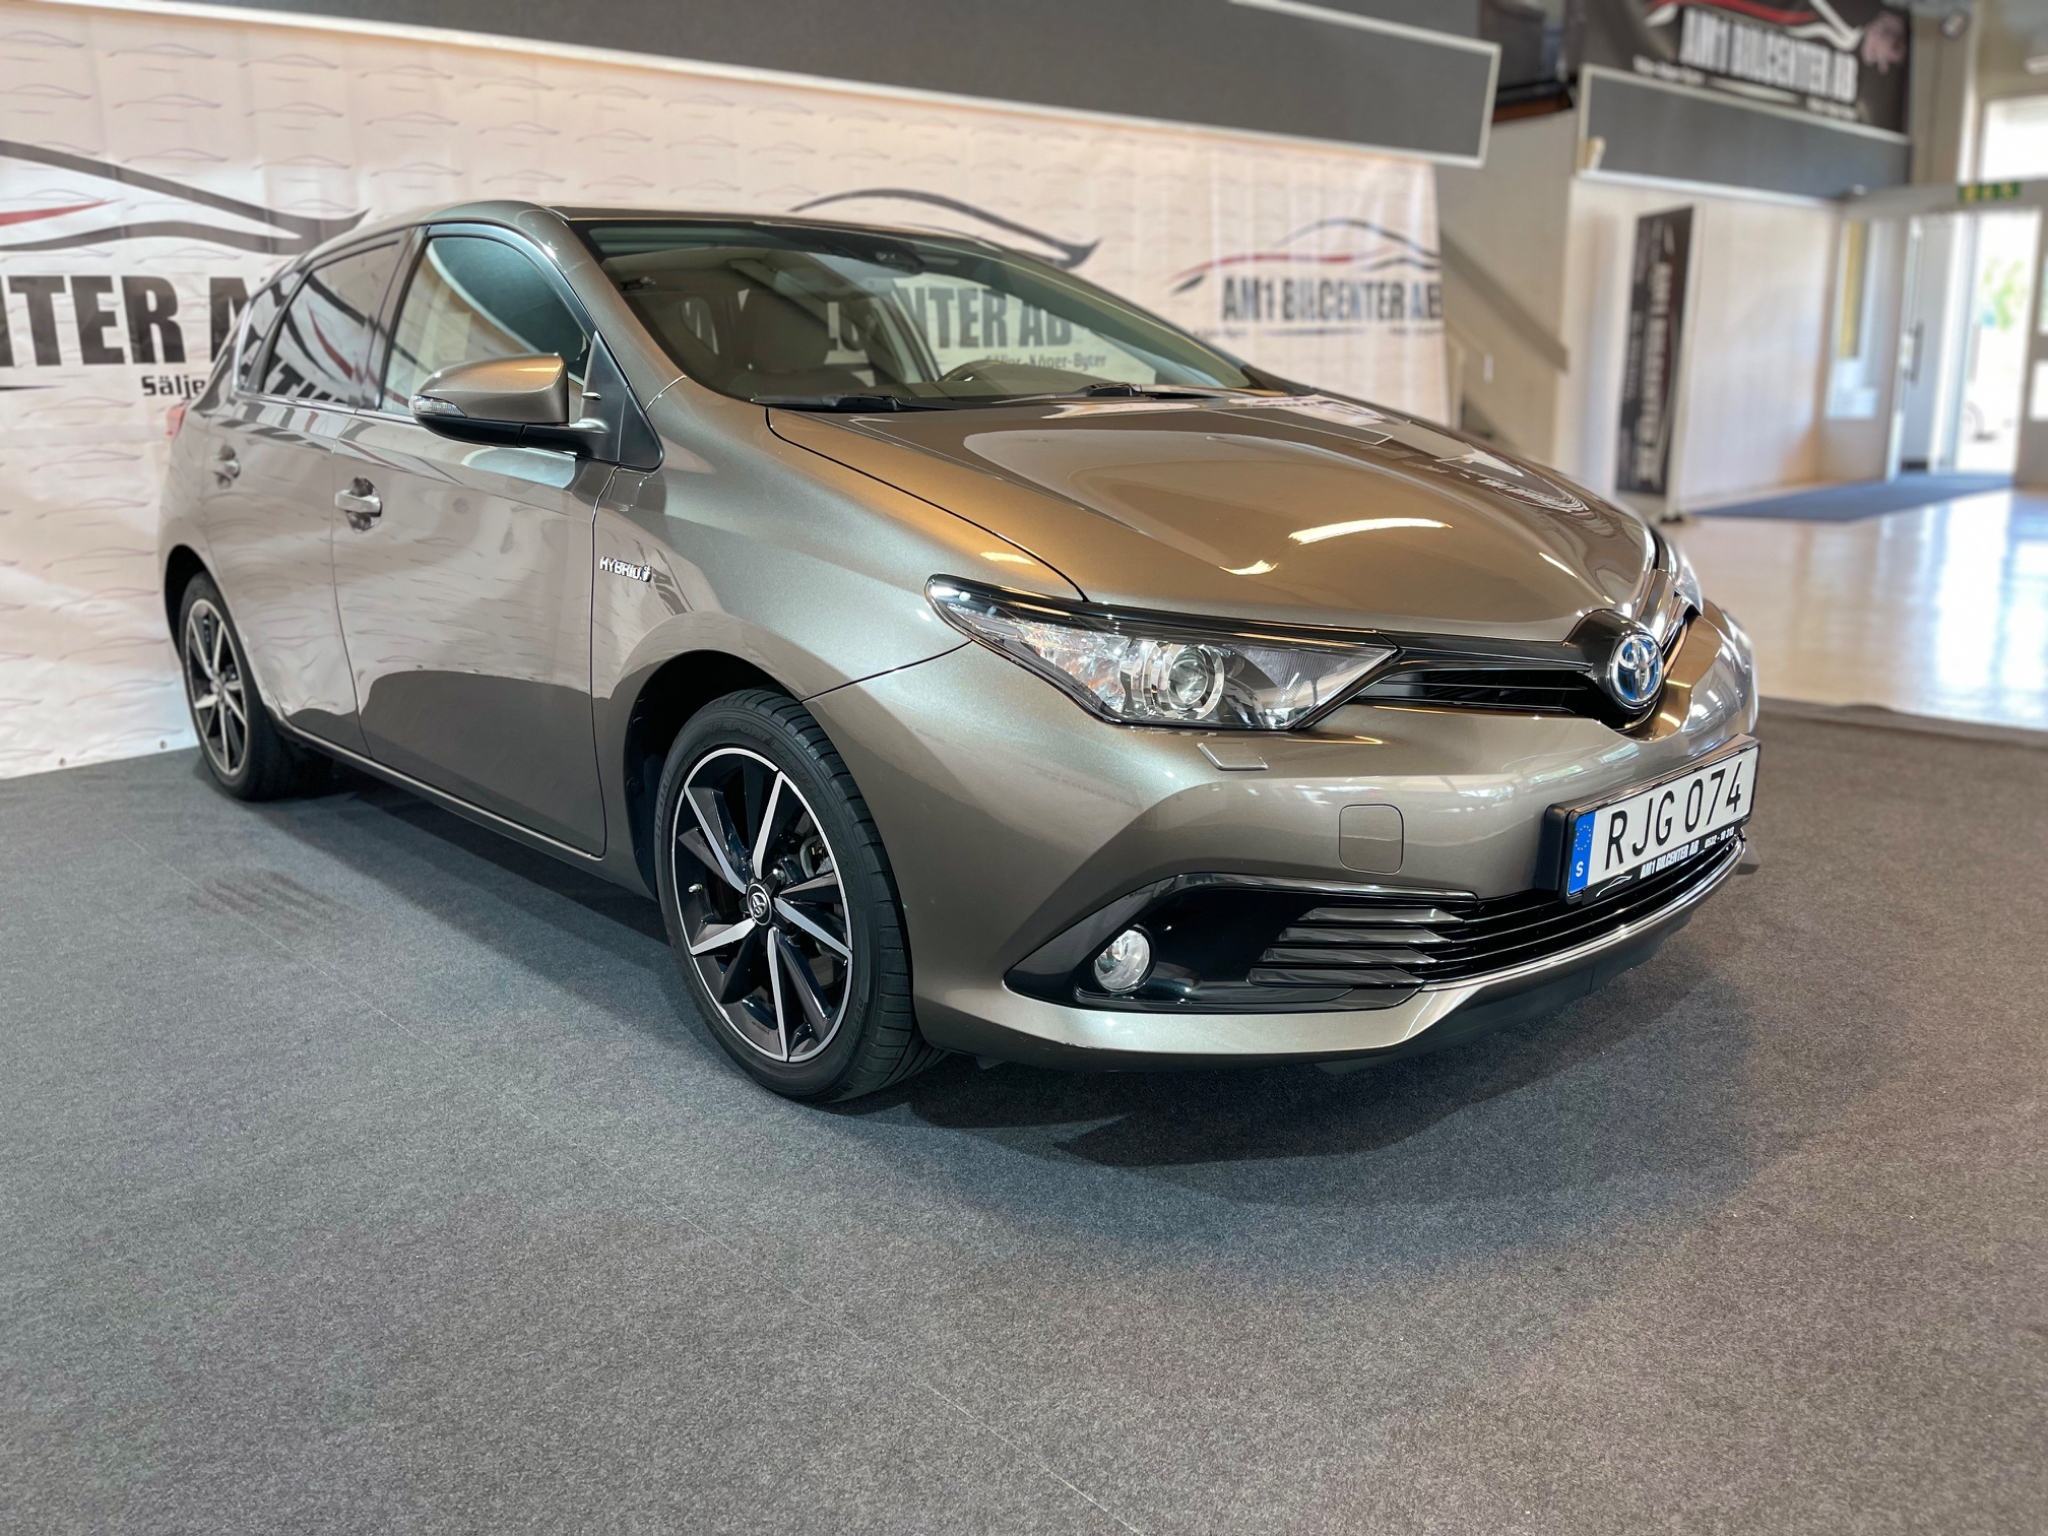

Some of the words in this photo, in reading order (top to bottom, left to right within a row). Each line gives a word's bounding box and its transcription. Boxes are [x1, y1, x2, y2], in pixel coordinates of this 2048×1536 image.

[600, 556, 641, 580] HYBRID
[1605, 791, 1675, 870] RJG
[1685, 760, 1742, 833] 074
[1575, 861, 1584, 878] S
